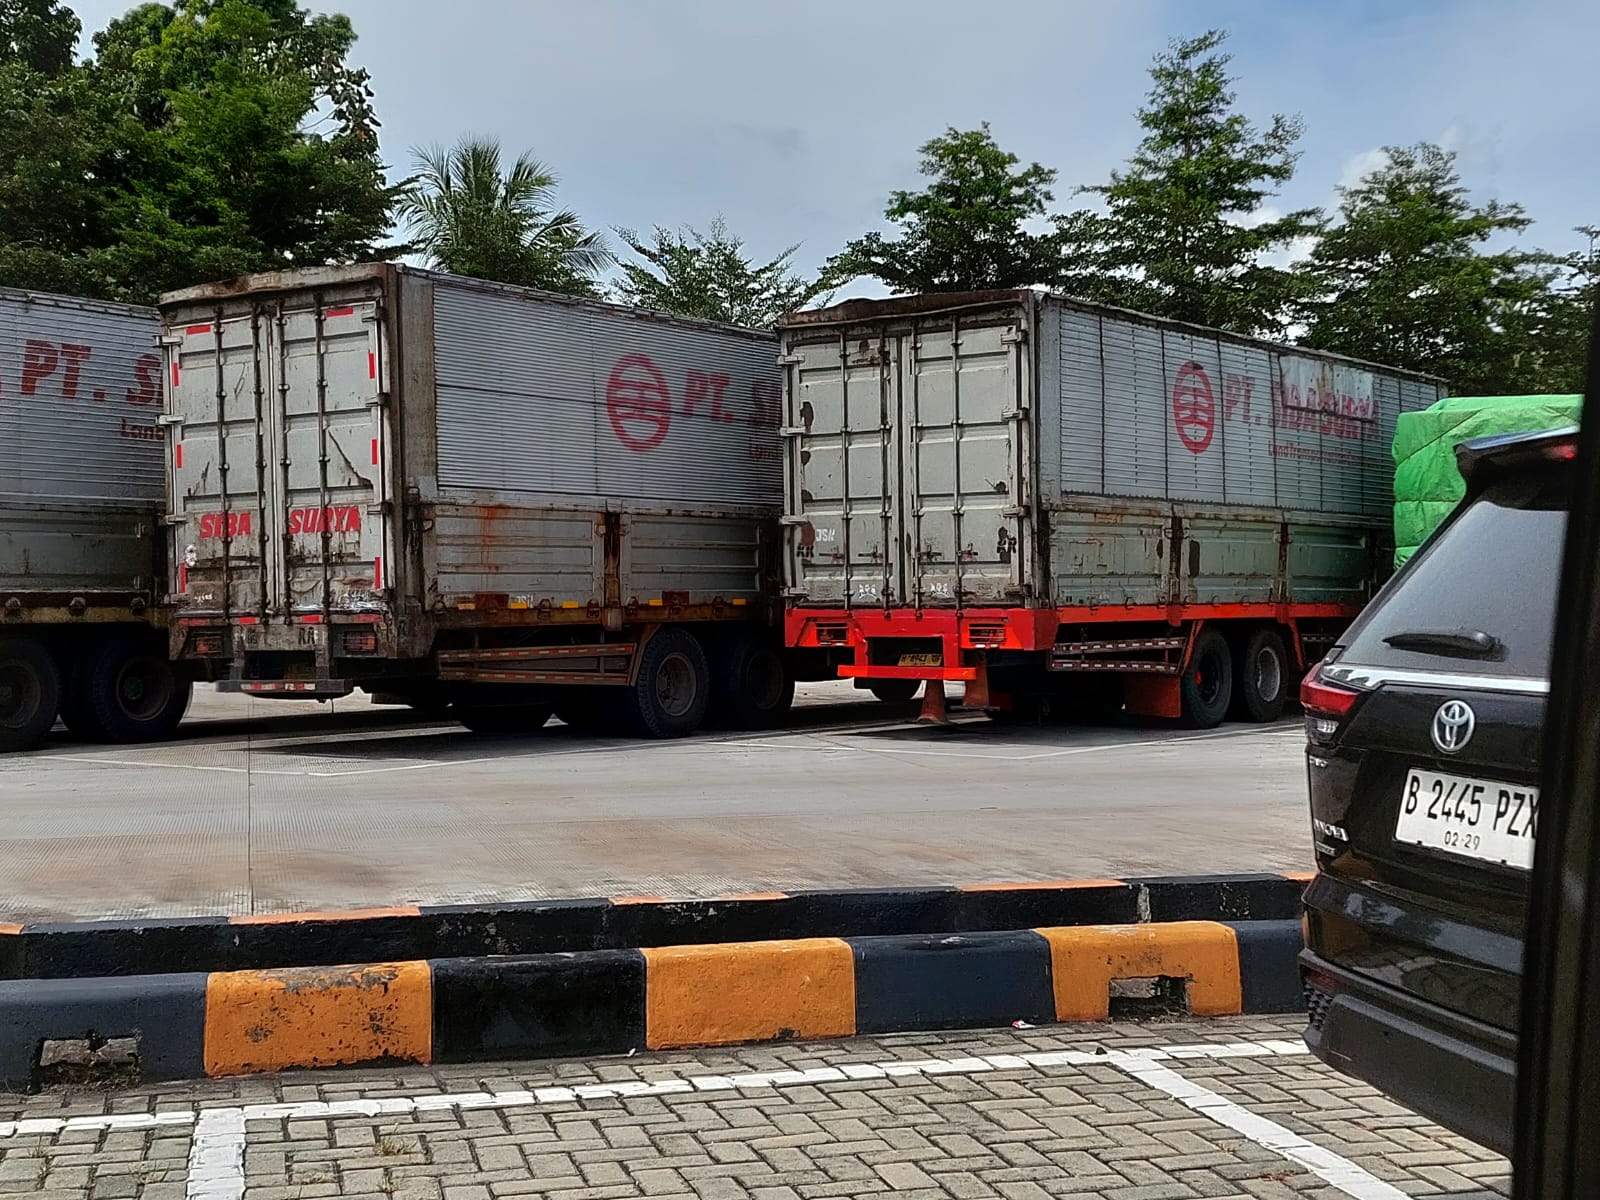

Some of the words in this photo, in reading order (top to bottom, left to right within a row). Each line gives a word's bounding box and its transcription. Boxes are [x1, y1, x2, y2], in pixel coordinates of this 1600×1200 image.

[200, 512, 251, 539] SIBA
[289, 506, 361, 534] SURYA
[1405, 775, 1421, 815] B
[1427, 779, 1485, 826] 2445
[1492, 789, 1539, 839] PZX
